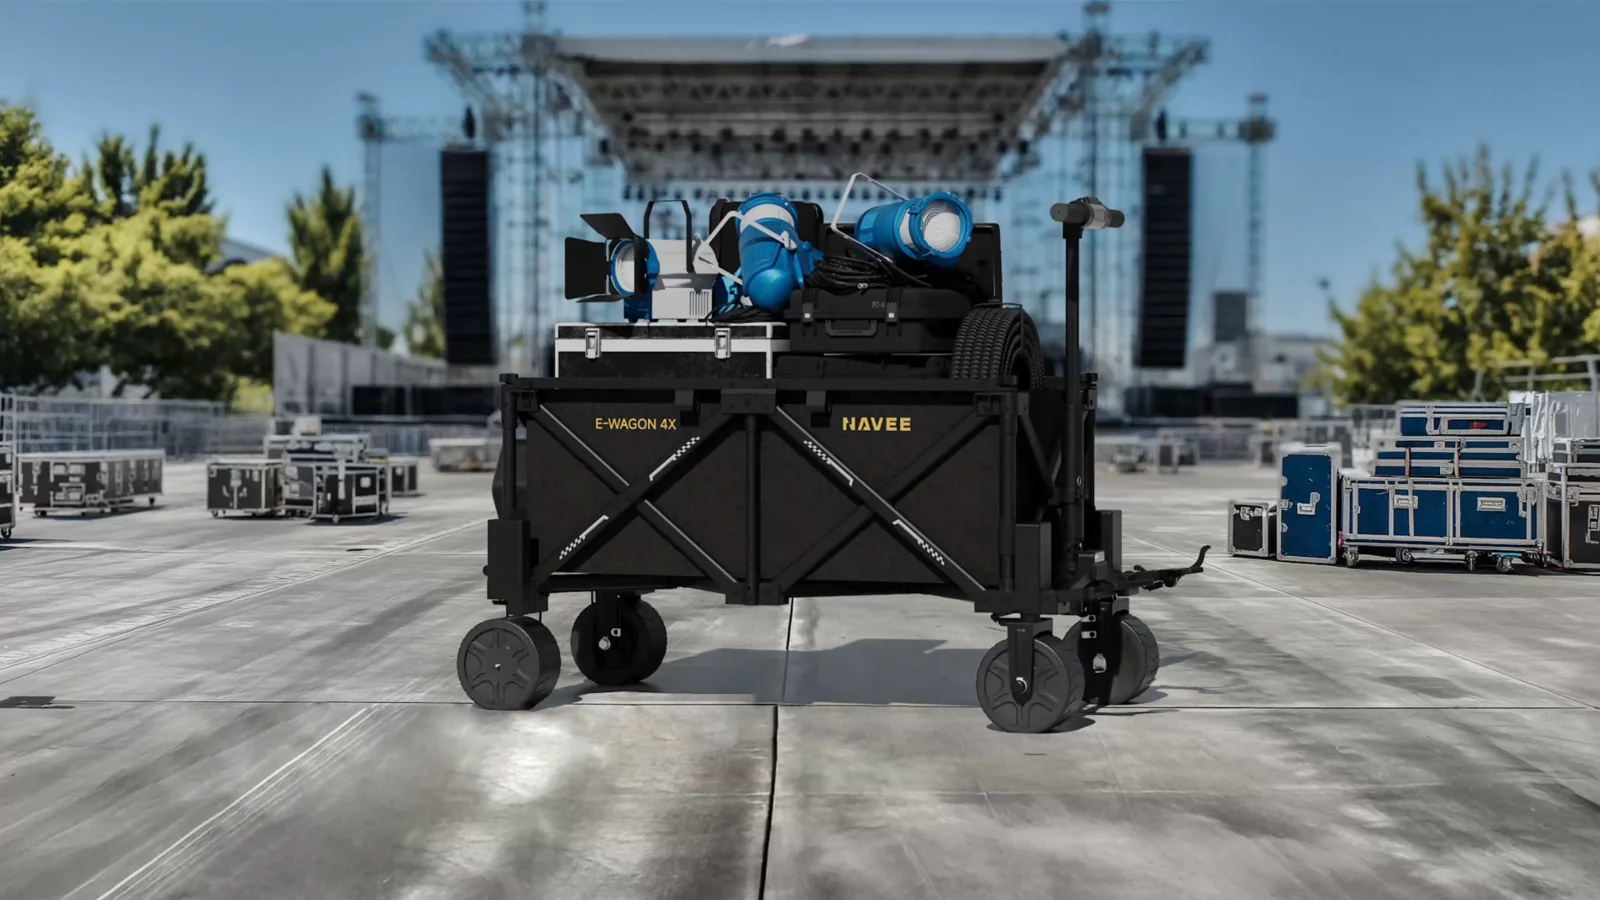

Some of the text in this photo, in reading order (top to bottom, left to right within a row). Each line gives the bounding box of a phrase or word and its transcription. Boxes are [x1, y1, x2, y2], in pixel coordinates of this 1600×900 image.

[595, 417, 677, 430] E-WAGON 4X
[842, 416, 912, 432] NAVEE
